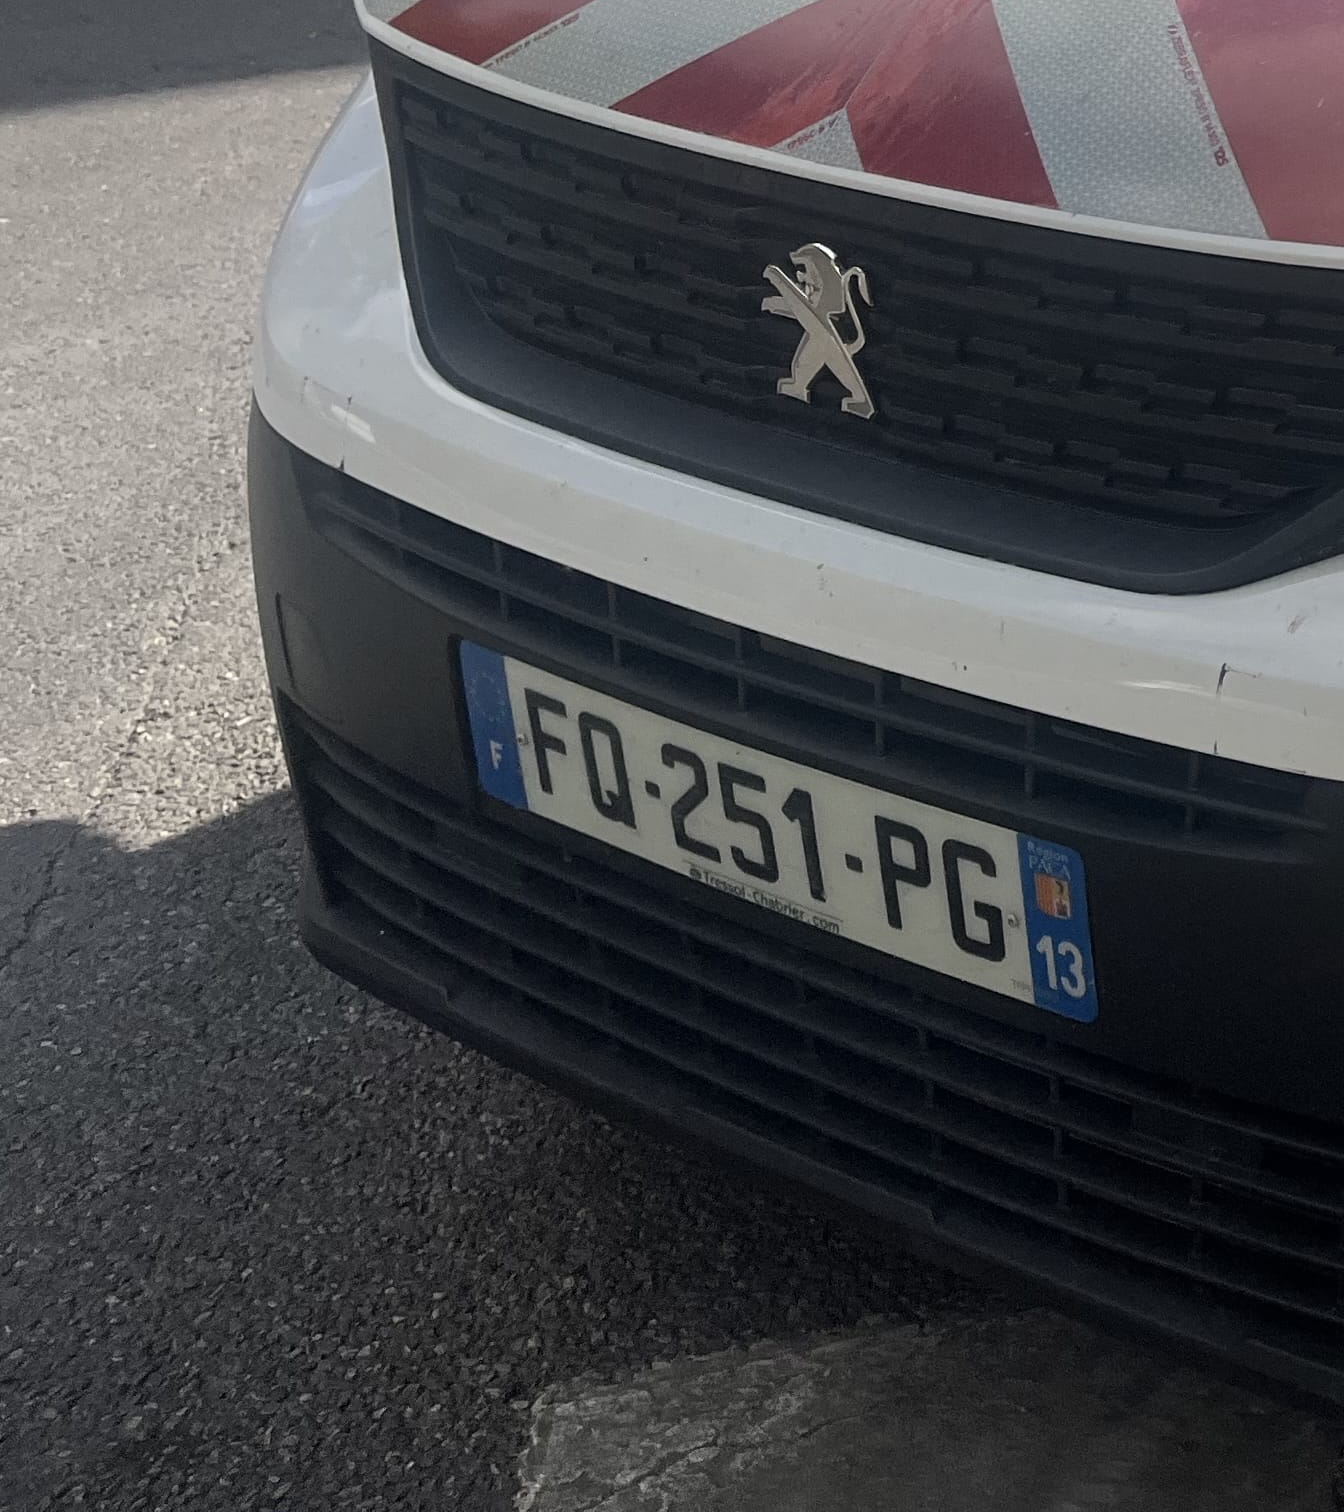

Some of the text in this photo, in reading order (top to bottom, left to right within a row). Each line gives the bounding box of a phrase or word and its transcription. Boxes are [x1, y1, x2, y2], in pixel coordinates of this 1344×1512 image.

[488, 740, 504, 771] F
[524, 687, 1006, 963] FQ-251-PG
[1036, 934, 1087, 999] 13
